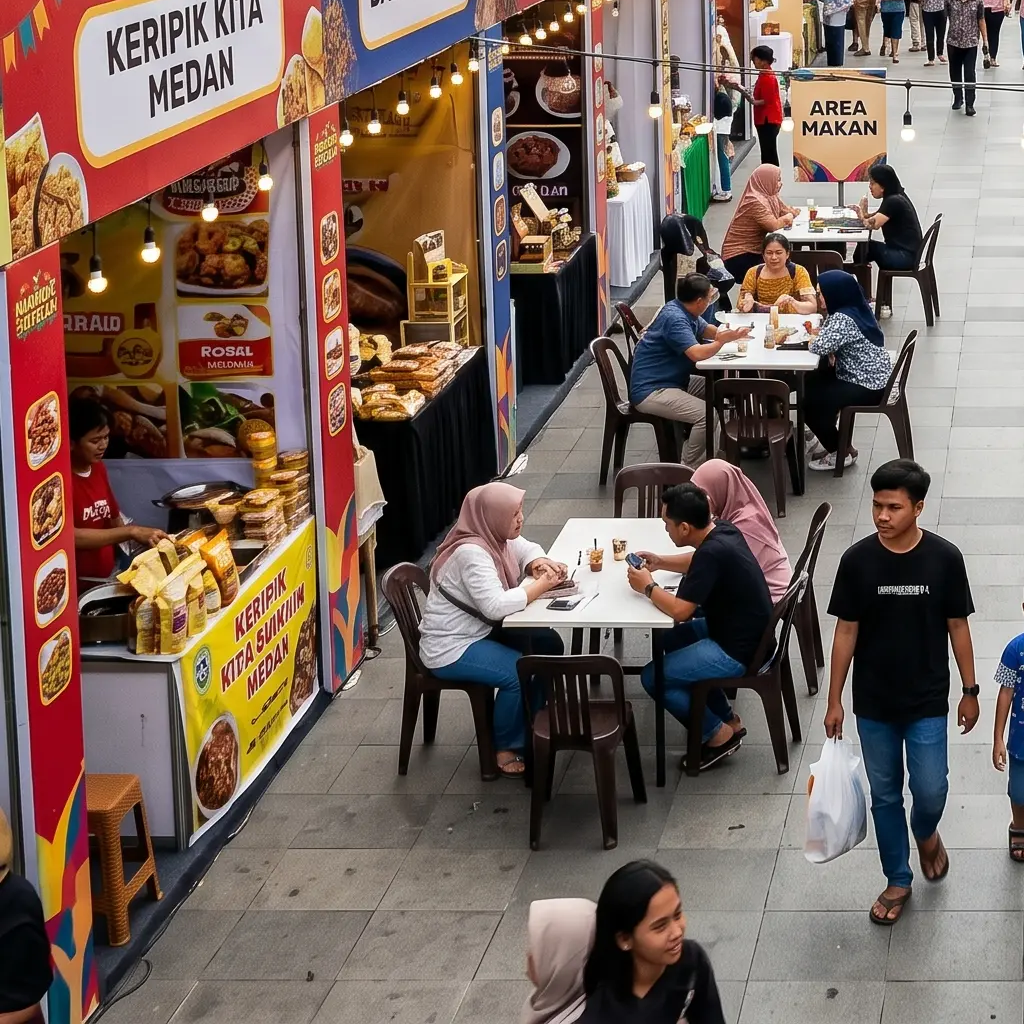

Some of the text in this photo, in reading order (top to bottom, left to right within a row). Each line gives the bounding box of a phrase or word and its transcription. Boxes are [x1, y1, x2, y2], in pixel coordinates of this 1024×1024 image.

[106, 2, 209, 76] KERIPIK
[148, 46, 234, 119] MEDAN
[802, 120, 877, 136] MAKAN
[809, 100, 868, 116] AREA
[201, 346, 254, 357] ROSAL
[235, 567, 288, 644] KERIPIK
